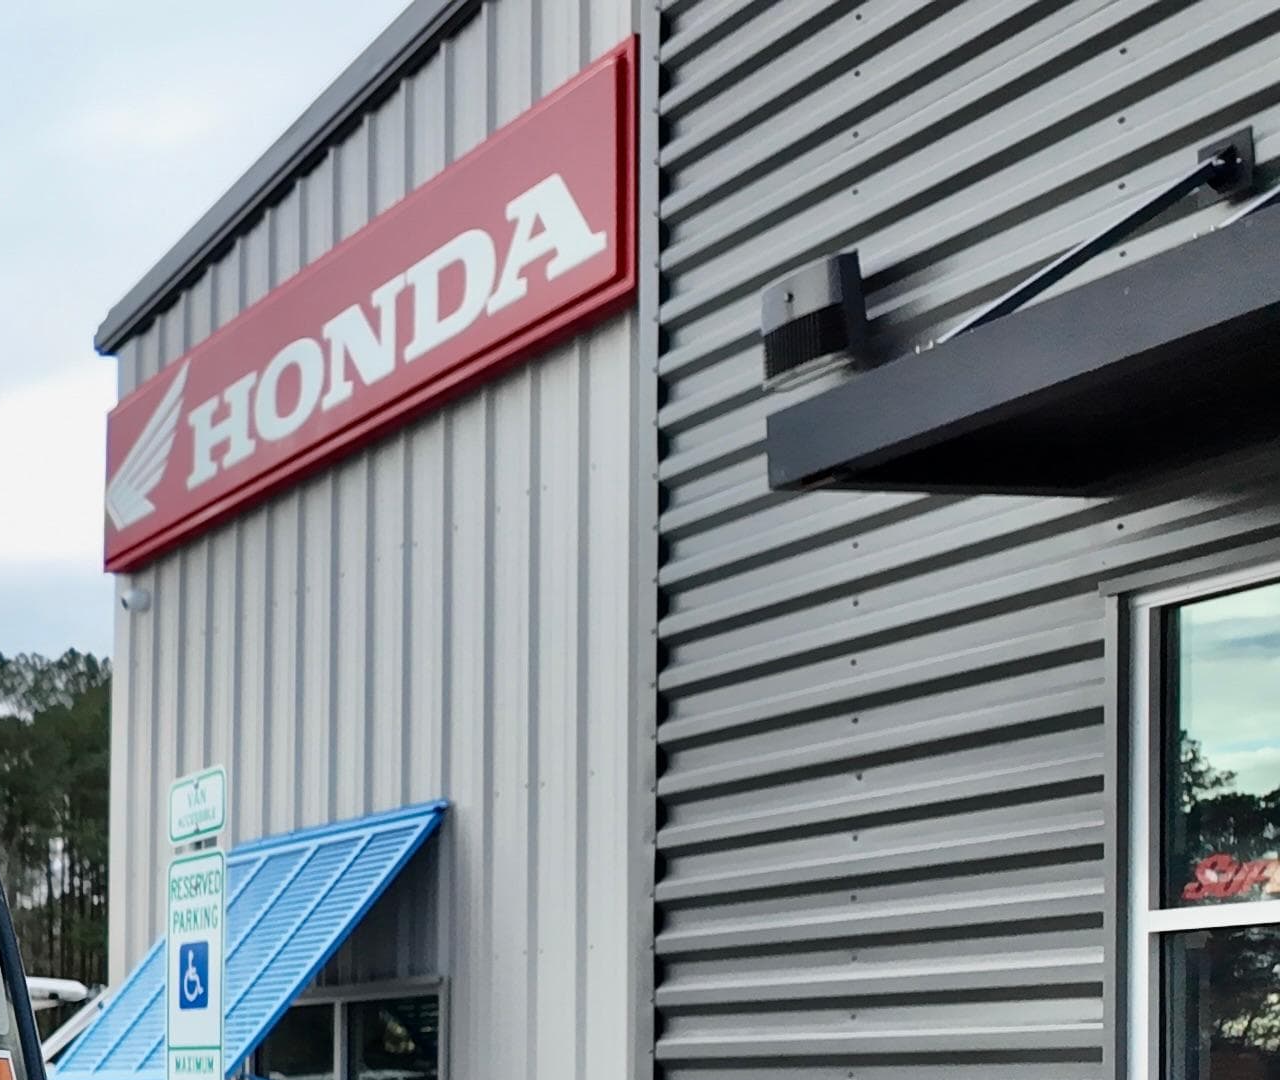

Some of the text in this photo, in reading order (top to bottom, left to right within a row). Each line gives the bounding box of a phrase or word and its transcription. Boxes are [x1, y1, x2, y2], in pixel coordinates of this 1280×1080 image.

[187, 173, 606, 490] HONDA
[171, 870, 220, 900] RESERVED
[173, 904, 218, 934] PARKING
[175, 1056, 214, 1073] MAXIMUM
